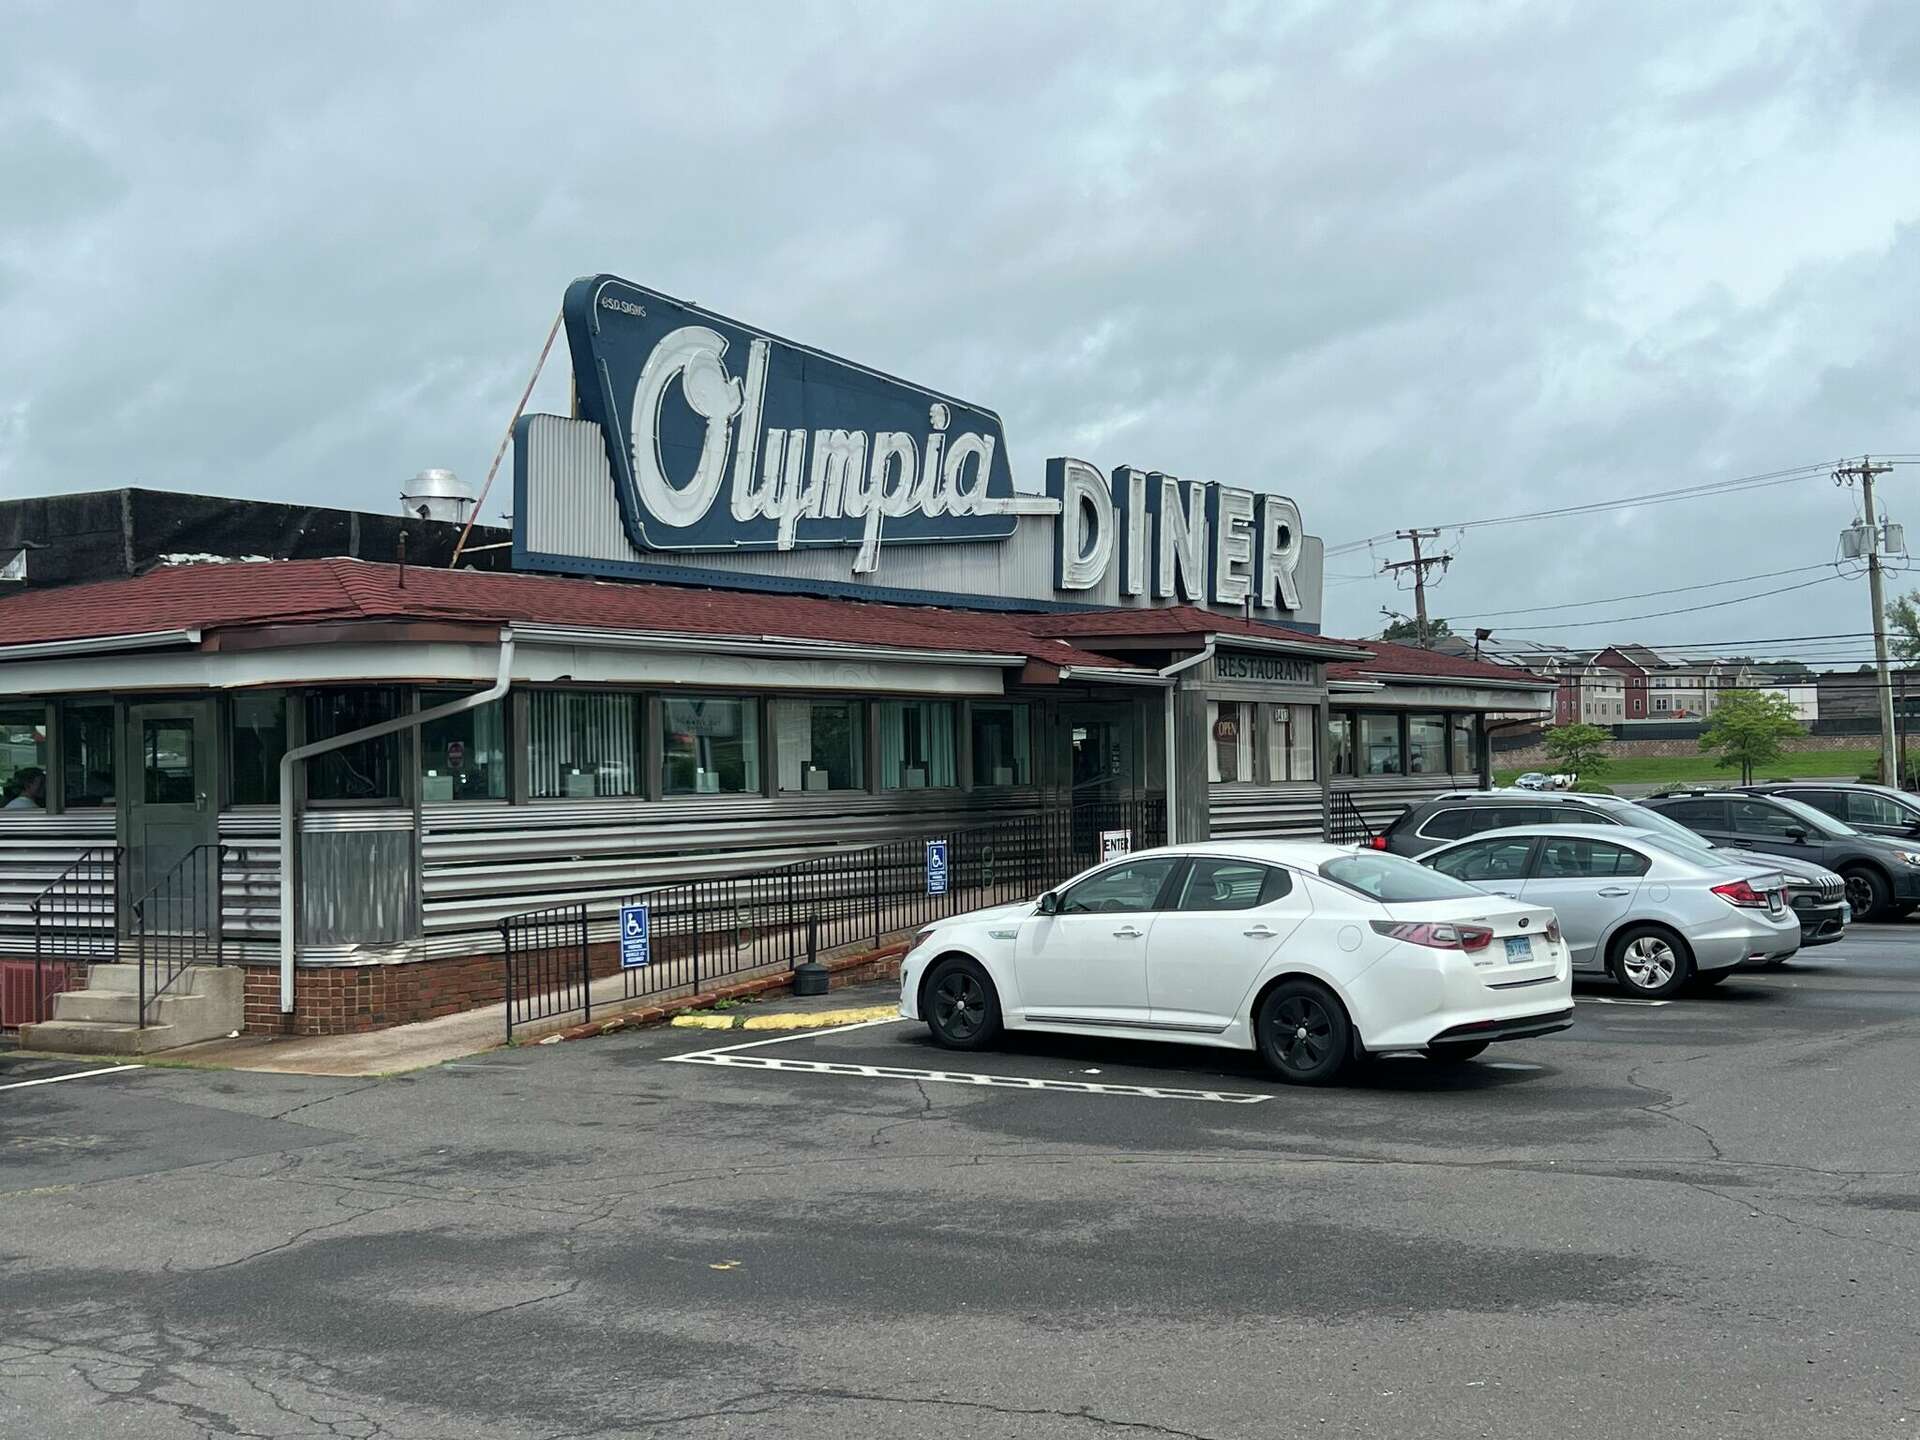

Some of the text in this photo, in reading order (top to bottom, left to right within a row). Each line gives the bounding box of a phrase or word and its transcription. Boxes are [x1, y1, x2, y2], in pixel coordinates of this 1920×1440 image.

[631, 326, 1002, 573] Olympia
[1046, 456, 1303, 610] DINER
[1218, 657, 1311, 681] RESTAURANT
[1218, 721, 1237, 737] OPEN
[1104, 838, 1129, 851] ENTER
